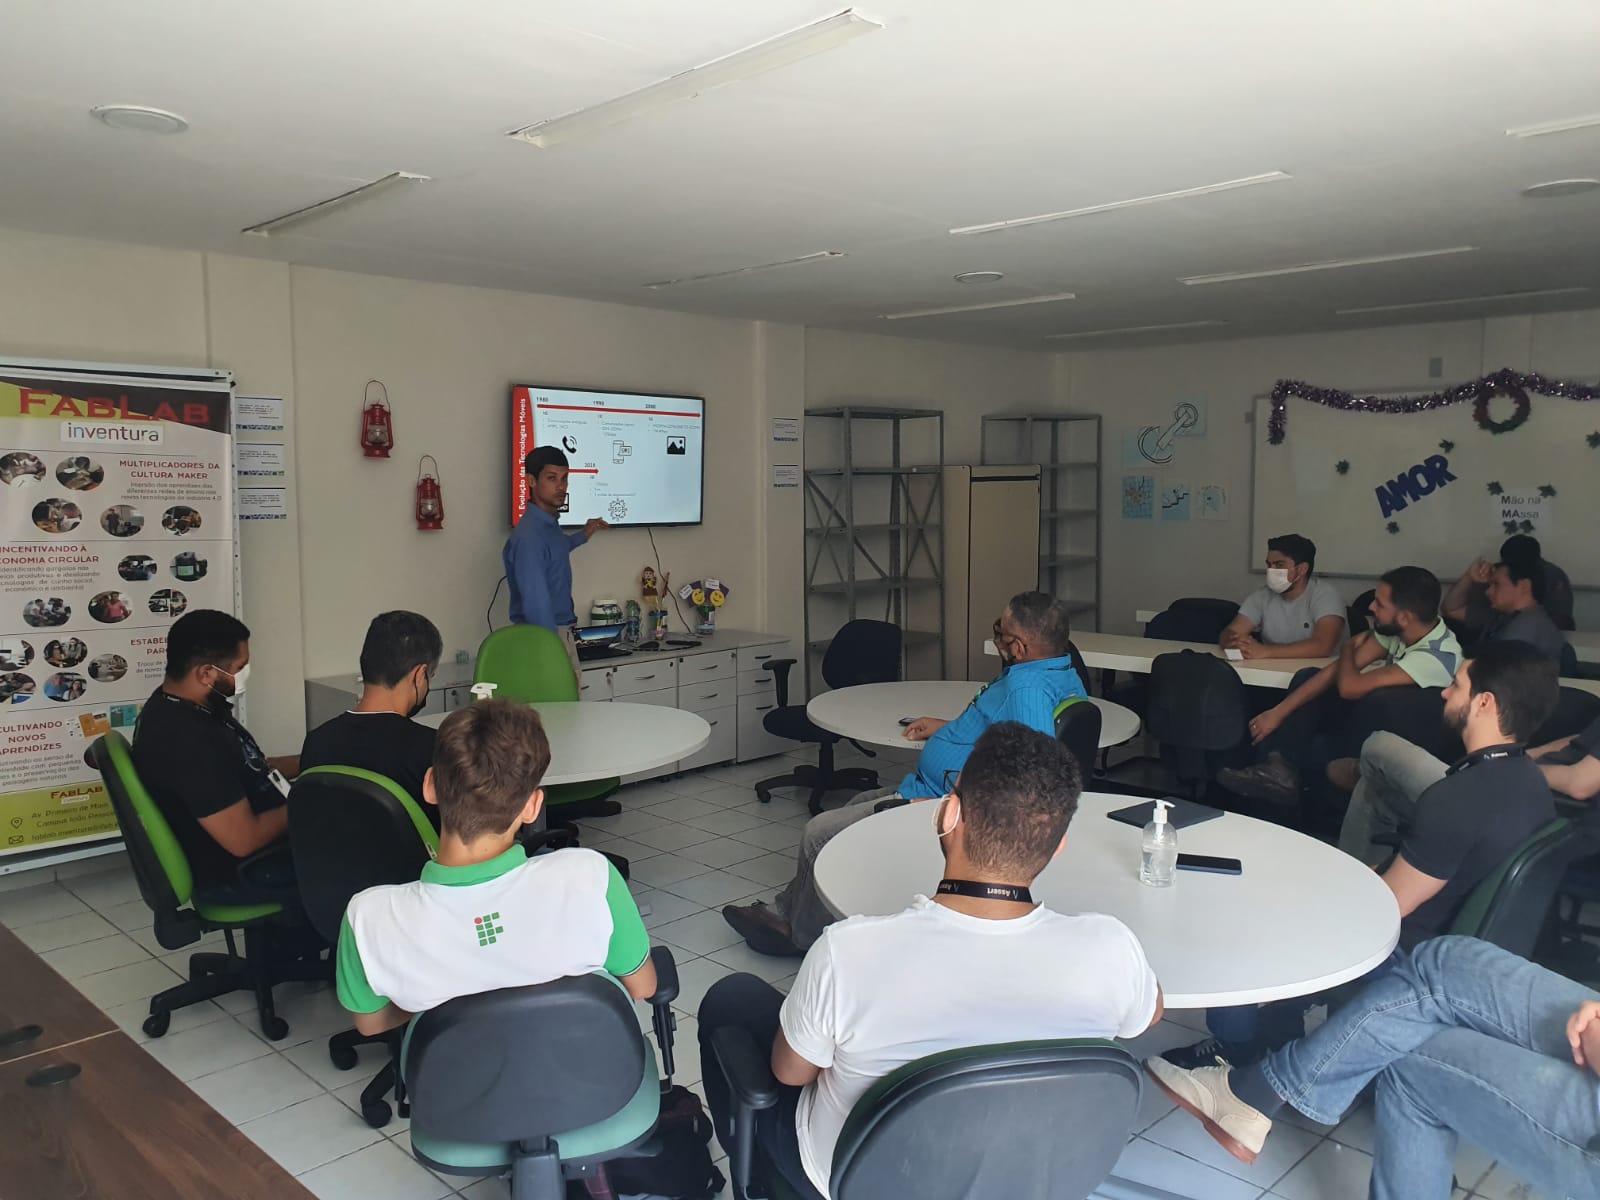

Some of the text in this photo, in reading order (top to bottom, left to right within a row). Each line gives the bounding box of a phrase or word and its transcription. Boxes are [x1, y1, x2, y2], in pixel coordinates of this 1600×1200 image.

[67, 422, 159, 441] inventura
[519, 425, 527, 464] Tecnologias
[120, 460, 204, 469] MULTIPLICADORES
[131, 471, 208, 480] CULTURA MAKER
[1375, 454, 1458, 519] AMOR
[1501, 495, 1541, 505] Mão na
[1502, 510, 1540, 519] MAssa
[0, 545, 78, 553] INCENTIVANDO
[48, 555, 99, 563] CIRCULAR
[147, 648, 168, 656] PAR
[8, 733, 47, 743] NOVOS
[986, 887, 1011, 897] Assert
